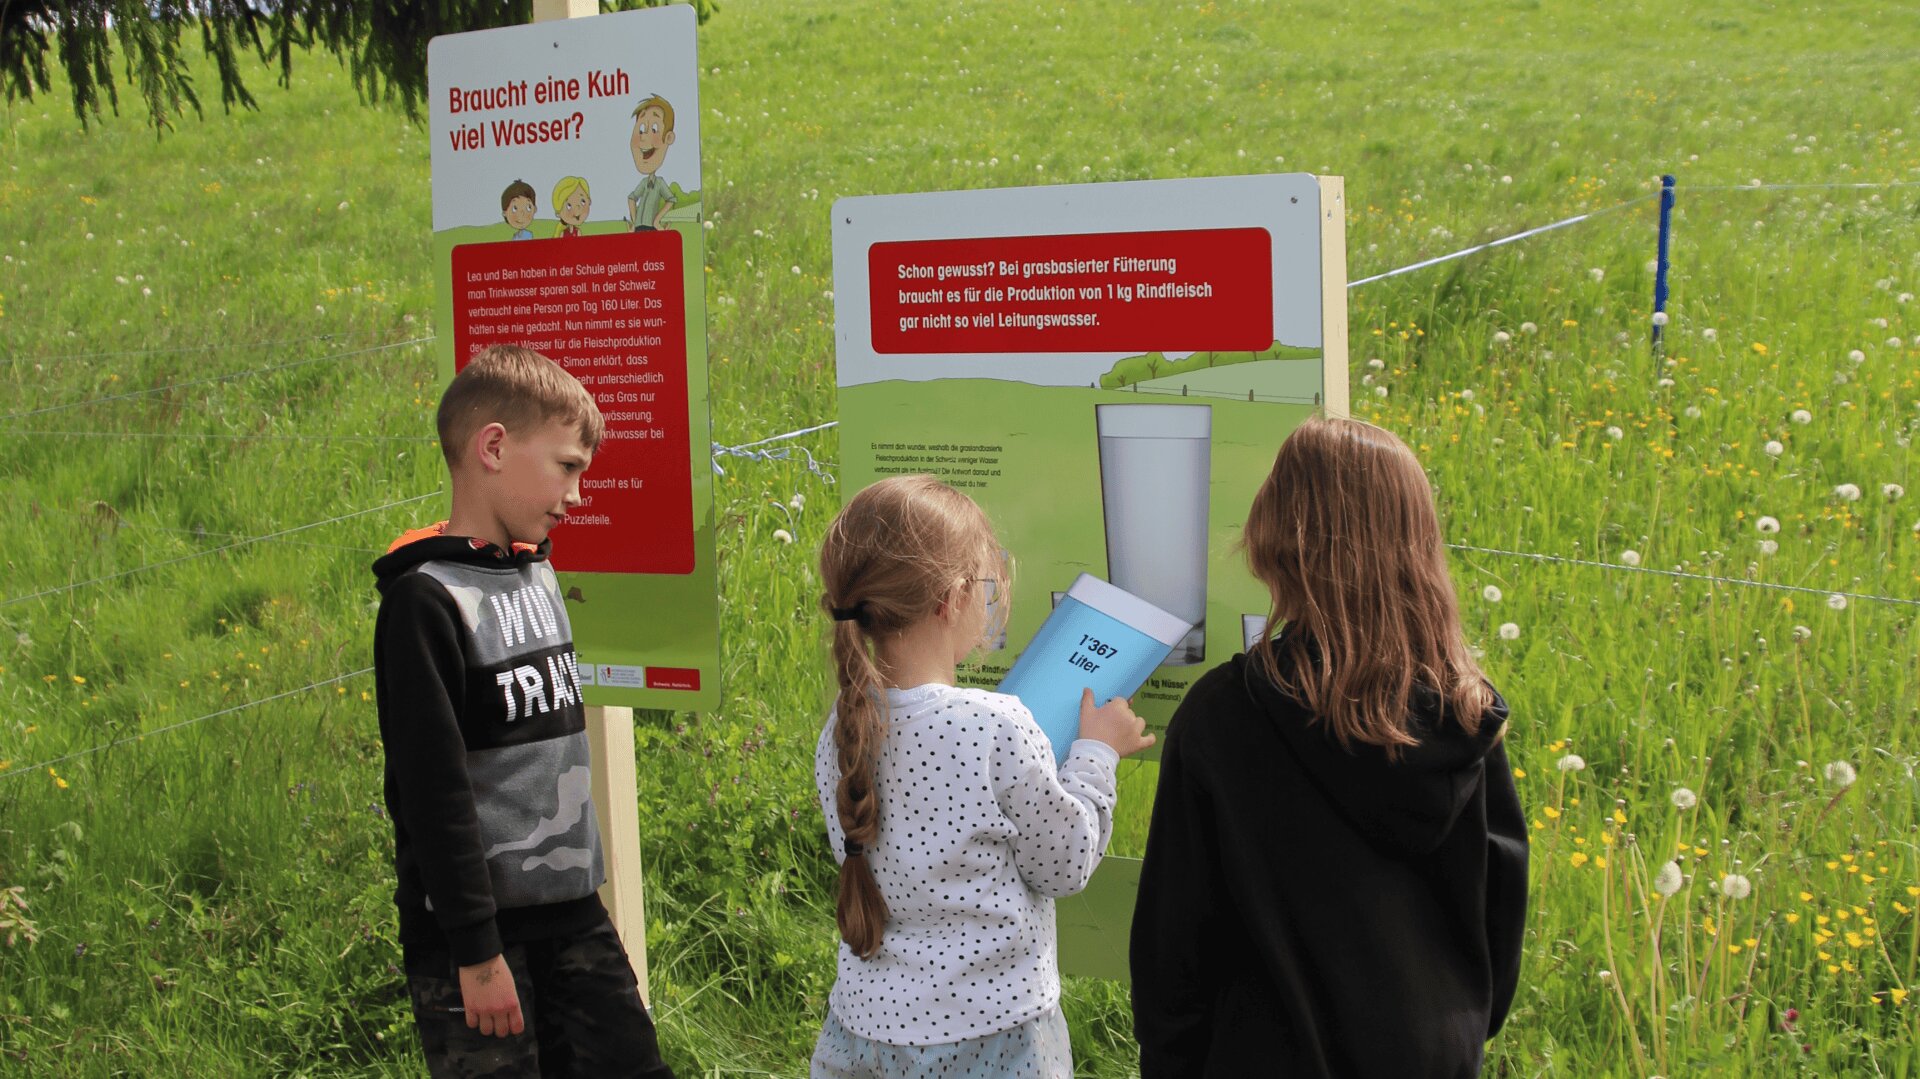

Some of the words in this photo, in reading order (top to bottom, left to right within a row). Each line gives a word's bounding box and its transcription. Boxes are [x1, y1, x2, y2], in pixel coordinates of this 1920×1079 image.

[450, 80, 528, 113] Braucht
[534, 75, 580, 104] eine
[588, 68, 629, 98] Kuh
[450, 122, 485, 151] viel
[491, 111, 584, 147] Wasser?
[467, 271, 482, 282] Lea
[484, 270, 500, 281] und
[502, 268, 518, 280] Ben
[520, 267, 547, 279] haben
[549, 266, 558, 277] in
[559, 265, 574, 276] der
[575, 264, 605, 276] Schule
[607, 261, 640, 276] gelernt,
[642, 260, 665, 272] dass
[898, 264, 934, 279] Schon
[938, 261, 995, 281] gewusst?
[999, 260, 1019, 276] Bei
[1023, 259, 1109, 278] grasbasierter
[1113, 256, 1177, 275] Fütterung
[467, 290, 486, 300] man
[488, 286, 537, 299] Trinkwasser
[539, 285, 569, 298] sparen
[571, 283, 589, 294] soll.
[592, 282, 600, 293] In
[602, 281, 617, 292] der
[619, 279, 656, 292] Schweiz
[899, 288, 944, 304] braucht
[946, 290, 961, 303] es
[964, 287, 981, 303] für
[984, 286, 1004, 302] die
[1007, 285, 1075, 301] Produktion
[1079, 287, 1102, 300] von
[1107, 284, 1113, 299] 1
[1117, 283, 1132, 302] kg
[1136, 281, 1213, 299] Rindfleisch
[468, 305, 512, 317] verbraucht
[513, 304, 531, 315] eine
[533, 303, 563, 314] Person
[565, 303, 580, 315] pro
[582, 300, 597, 314] Tag
[601, 299, 618, 311] 160
[620, 298, 641, 310] Liter.
[644, 297, 662, 309] Das
[469, 324, 494, 335] hätten
[497, 323, 509, 334] sie
[511, 322, 524, 333] nie
[526, 321, 562, 335] gedacht.
[565, 320, 583, 331] Nun
[585, 318, 613, 329] nimmt
[615, 319, 626, 329] es
[628, 317, 641, 328] sie
[643, 317, 667, 327] wun-
[899, 316, 919, 332] gar
[922, 313, 951, 329] nicht
[954, 315, 969, 328] so
[972, 313, 995, 328] viel
[998, 312, 1100, 330] Leitungswasser.
[520, 340, 552, 351] Wasser
[554, 338, 566, 350] für
[568, 338, 581, 349] die
[583, 335, 662, 350] Fleischproduktion
[563, 356, 591, 368] Simon
[593, 355, 623, 367] erklärt,
[626, 354, 648, 365] dass
[597, 372, 664, 384] unterschiedlich
[598, 392, 615, 403] das
[616, 391, 638, 402] Gras
[640, 392, 655, 402] nur
[603, 411, 654, 423] wässerung.
[600, 428, 648, 440] rinkwasser
[650, 427, 664, 439] bei
[582, 477, 616, 489] braucht
[617, 480, 629, 489] es
[631, 477, 643, 489] für
[564, 513, 612, 525] Puzzleteile.
[1068, 651, 1100, 673] Liter
[957, 675, 968, 683] bei
[1150, 678, 1160, 689] kg
